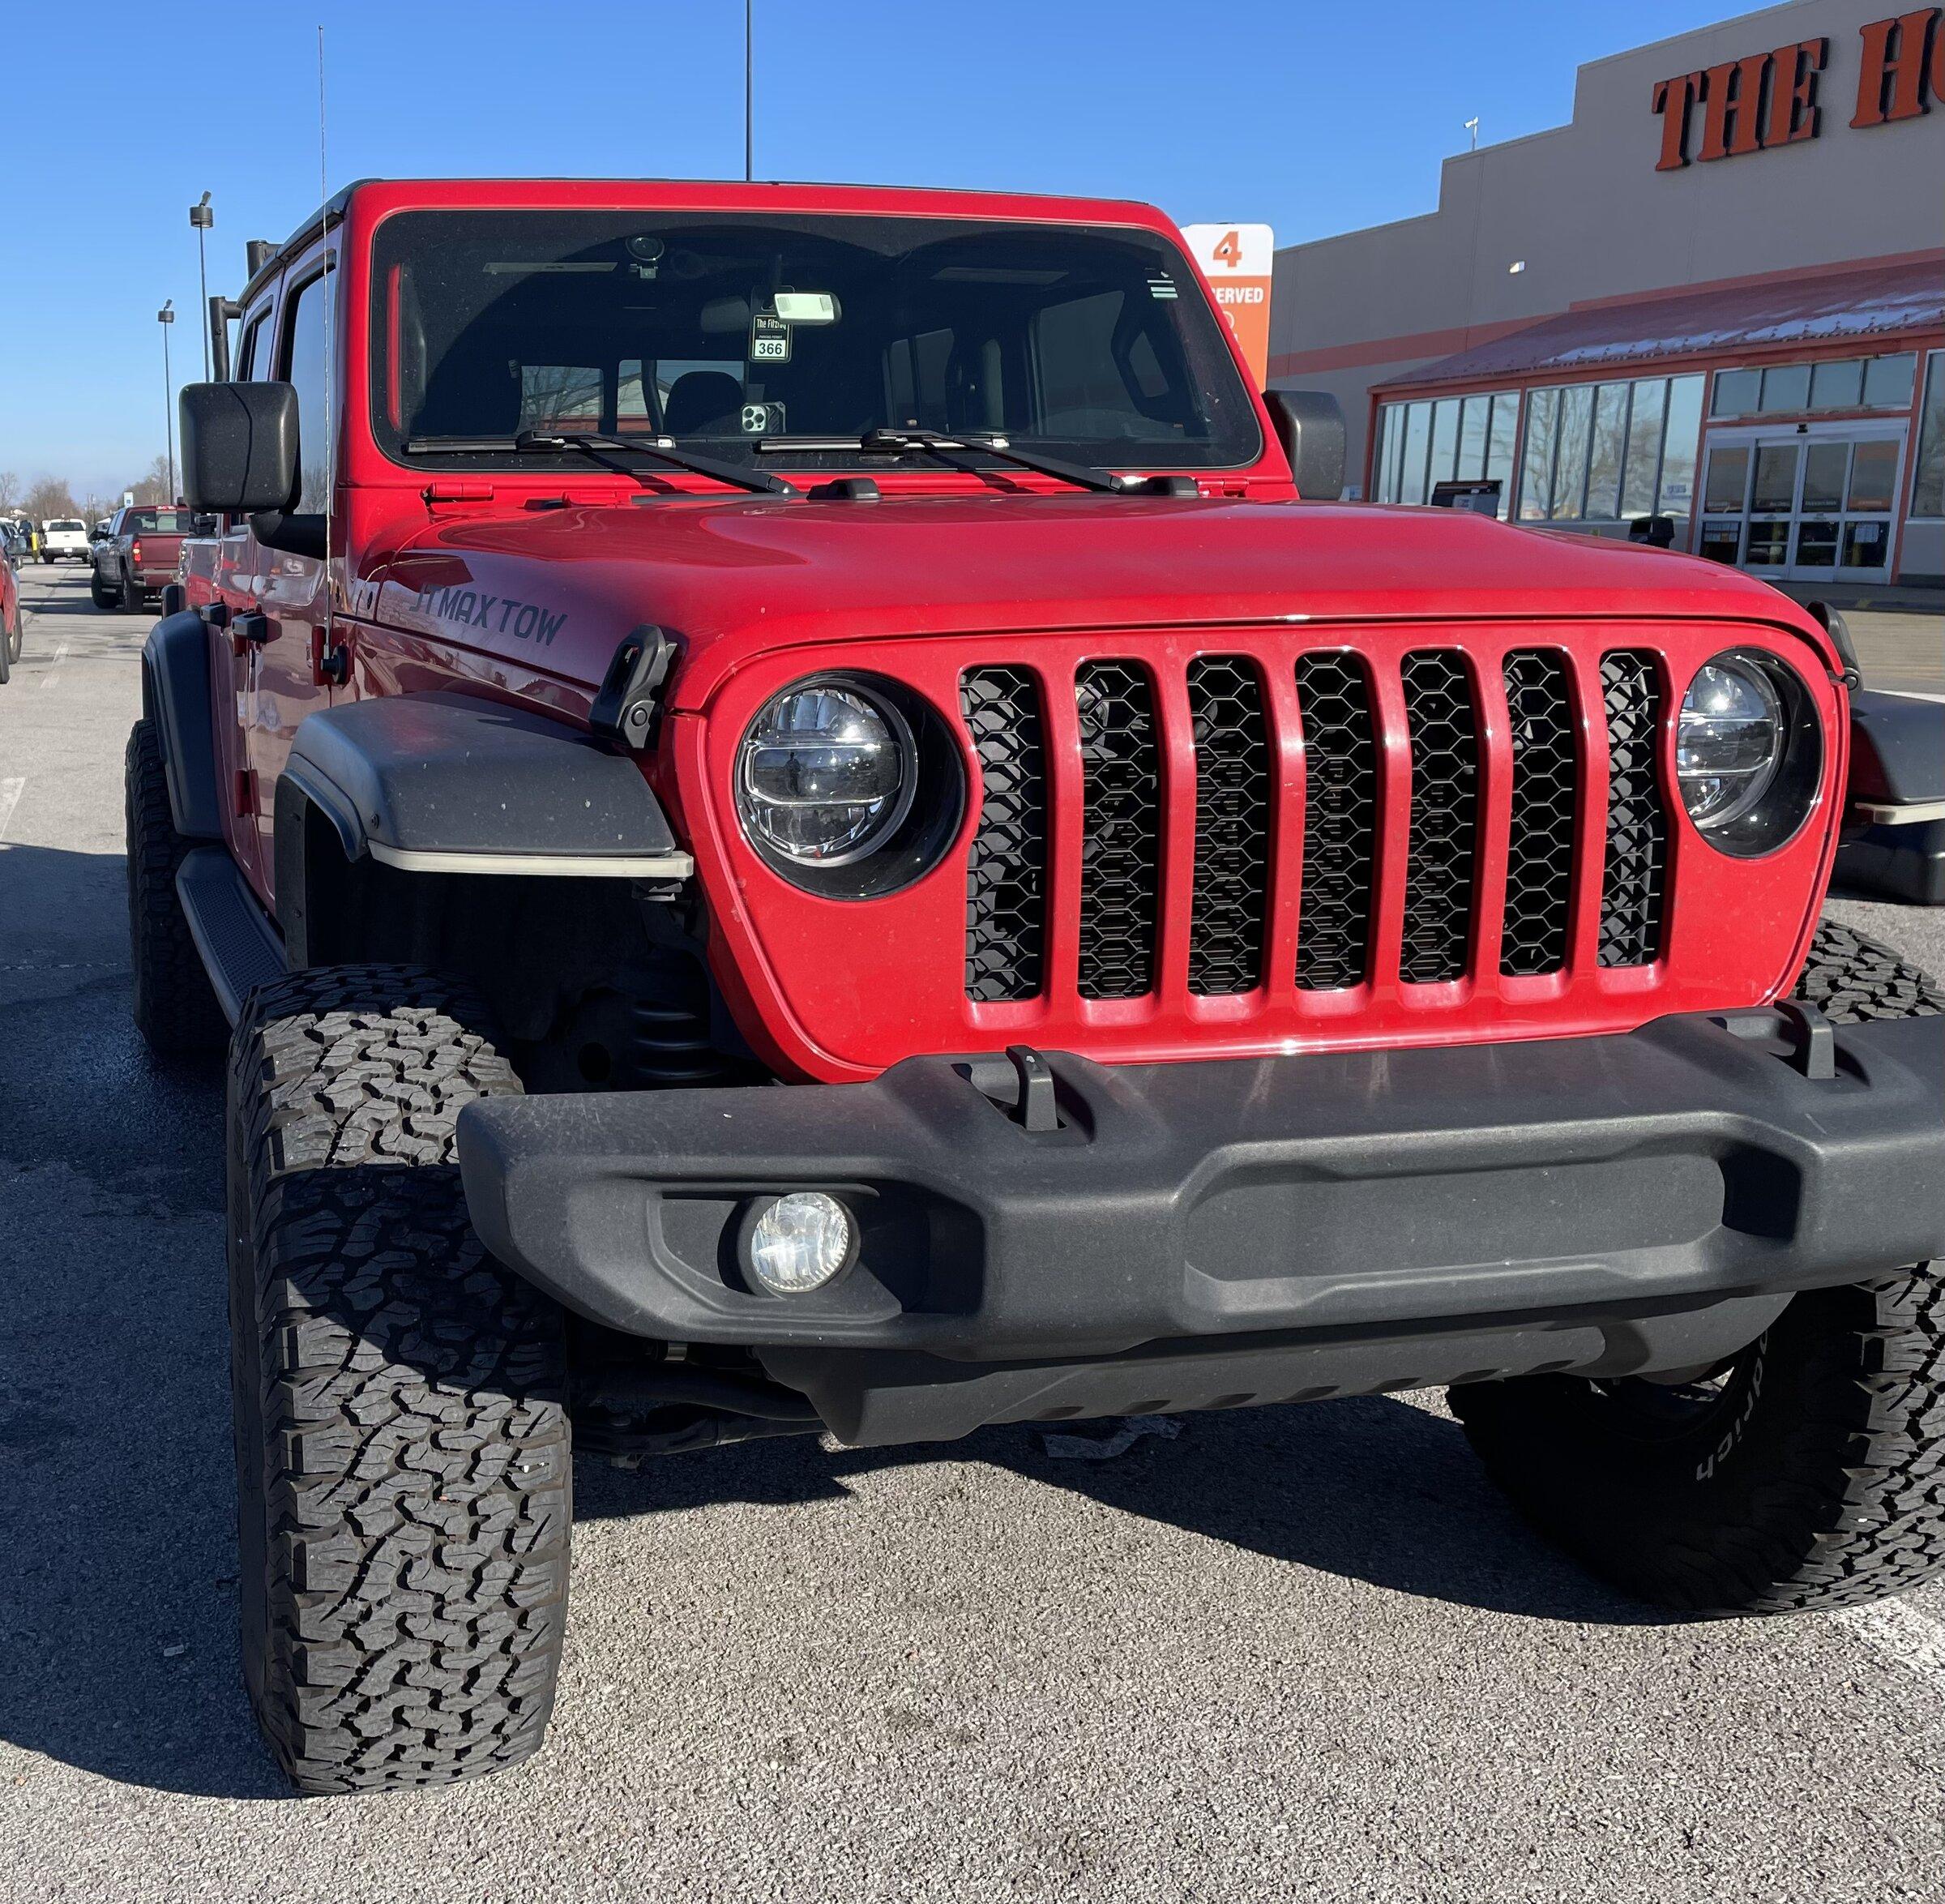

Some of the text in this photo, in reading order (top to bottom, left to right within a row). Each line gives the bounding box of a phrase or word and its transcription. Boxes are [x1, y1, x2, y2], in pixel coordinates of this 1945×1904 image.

[1652, 7, 1945, 171] THE H
[1212, 231, 1243, 267] 4
[1212, 287, 1263, 304] ERVED
[757, 319, 767, 329] The
[759, 343, 783, 355] 366
[498, 599, 568, 646] TOW
